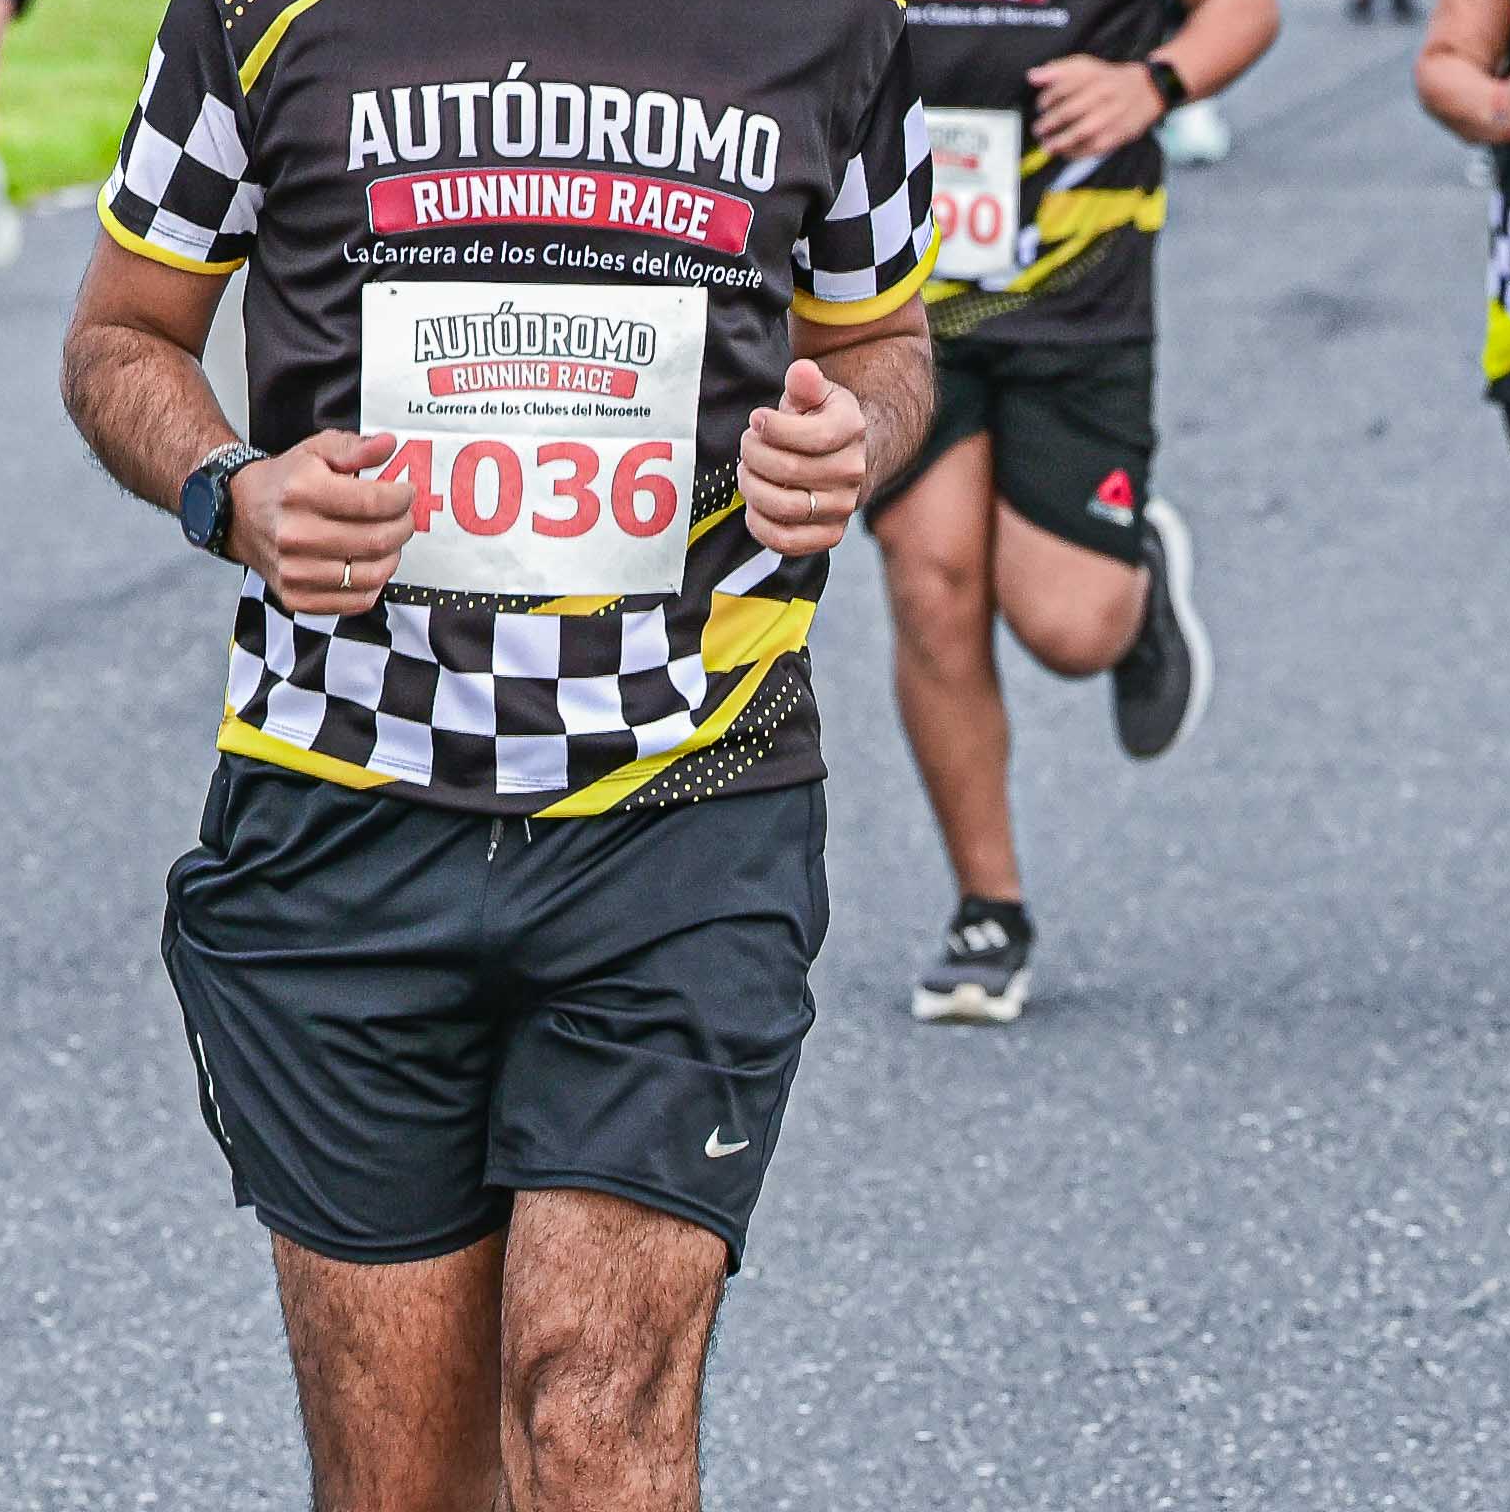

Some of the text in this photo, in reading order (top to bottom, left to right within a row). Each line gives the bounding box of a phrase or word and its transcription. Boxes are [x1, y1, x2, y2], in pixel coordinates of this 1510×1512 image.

[346, 61, 781, 193] AUTÓDROMO
[411, 174, 716, 241] RUNNING RACE
[343, 240, 764, 290] La Carrera de los Clubes del Noroeste
[414, 301, 657, 366] AUTÓDROMO
[407, 400, 652, 419] La Carrera de los Clubes del Noroeste
[452, 363, 615, 394] RUNNING RACE
[375, 439, 679, 539] 4036
